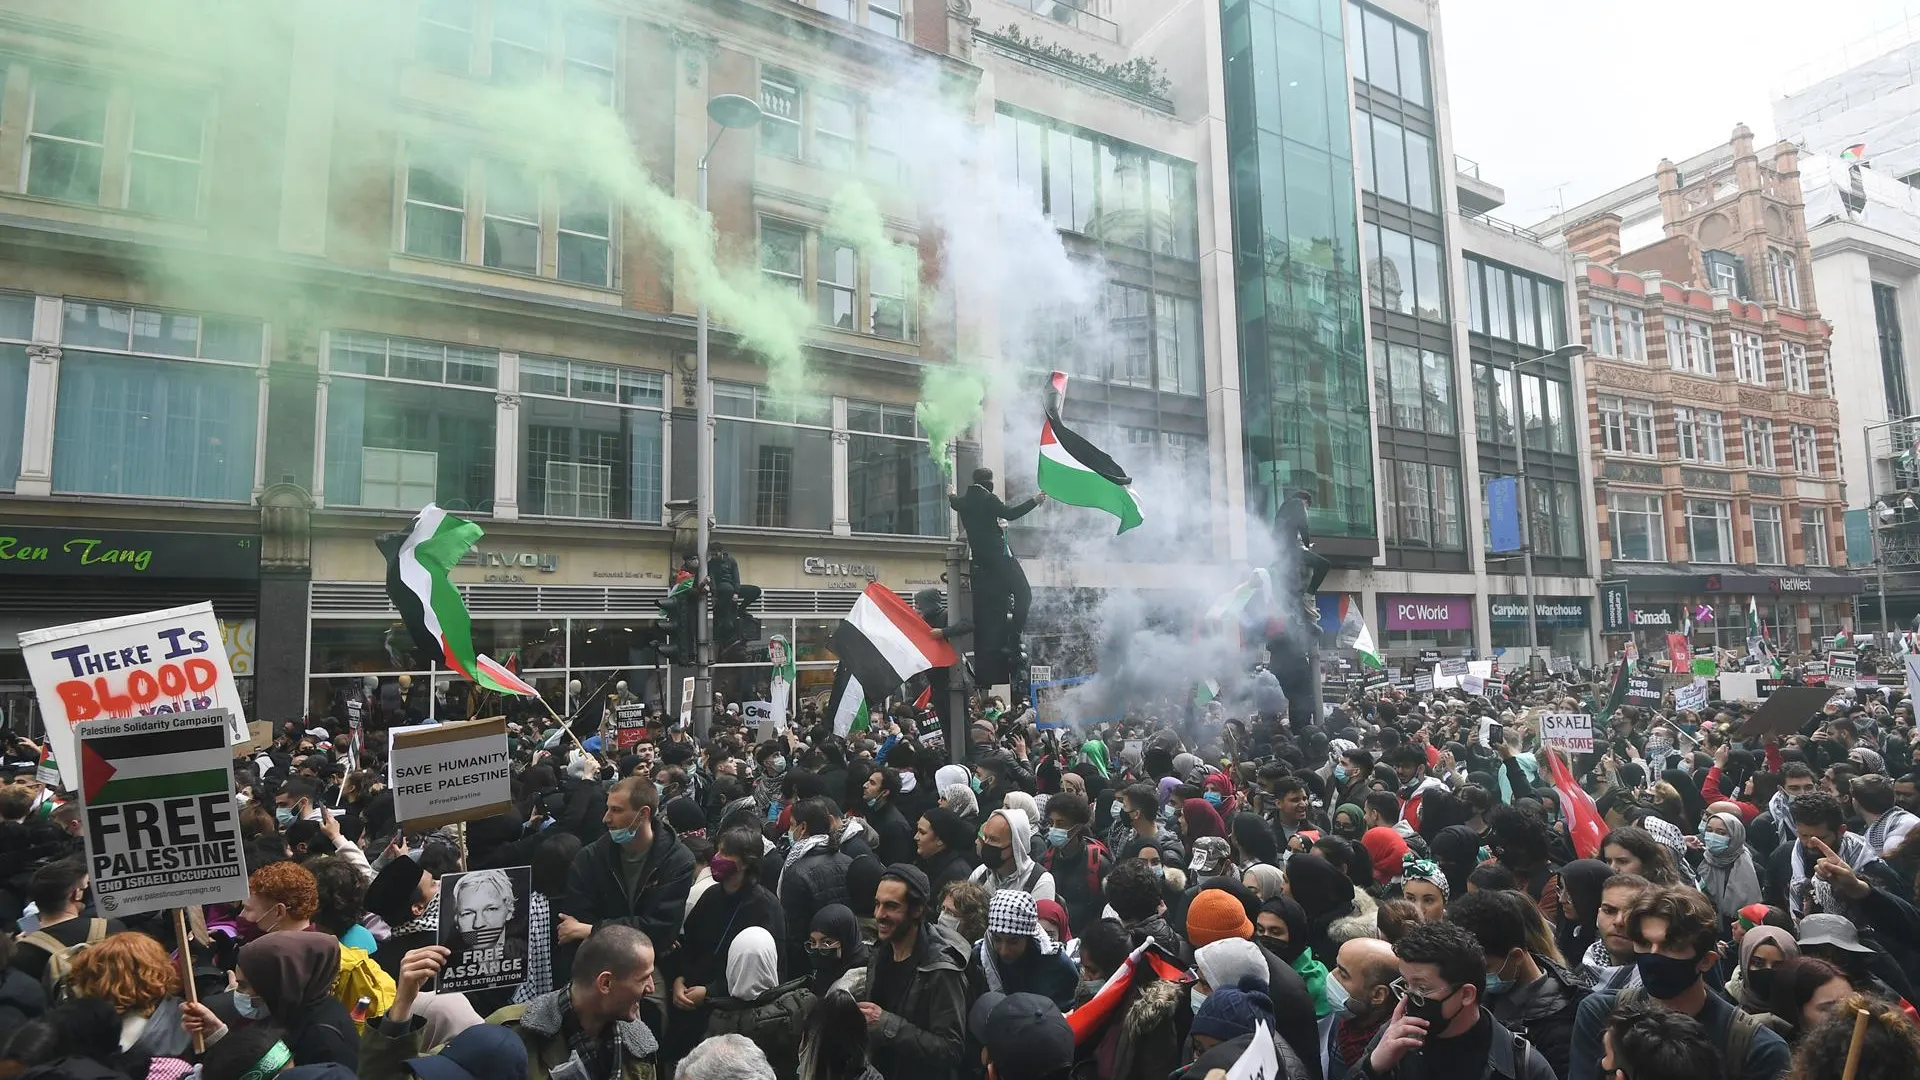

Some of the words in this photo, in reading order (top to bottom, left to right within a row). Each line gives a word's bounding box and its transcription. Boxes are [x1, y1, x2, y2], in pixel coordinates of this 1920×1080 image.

[238, 539, 251, 549] 41
[63, 539, 152, 570] Tang
[1780, 577, 1812, 591] NatWest
[1398, 604, 1415, 620] PC
[1418, 604, 1448, 620] World
[1535, 604, 1583, 616] Warehouse
[52, 644, 152, 678] THERE
[157, 627, 208, 660] IS
[1829, 667, 1856, 677] FREE
[56, 658, 218, 721] BLOOD
[618, 710, 642, 718] FREEDOM
[1541, 716, 1591, 729] ISRAEL
[81, 725, 121, 737] Palestine
[123, 720, 170, 733] Solidarity
[172, 714, 224, 728] Campaign
[618, 720, 644, 728] PALESTINE
[1568, 737, 1593, 749] STATE
[396, 764, 433, 778] SAVE
[438, 751, 508, 772] HUMANITY
[397, 782, 433, 796] FREE
[438, 768, 509, 790] PALESTINE
[429, 791, 482, 806] #FreePalestine
[87, 793, 236, 856] FREE
[93, 841, 239, 880] PALESTINE
[97, 880, 124, 893] END
[125, 873, 170, 889] ISRAELI
[172, 866, 239, 883] OCCUPATION
[122, 883, 222, 905] www.palestinecampaign.org
[462, 947, 504, 964] FREE
[443, 958, 522, 980] ASSANGE
[456, 980, 471, 988] U.S.
[471, 973, 522, 986] EXTRADITION
